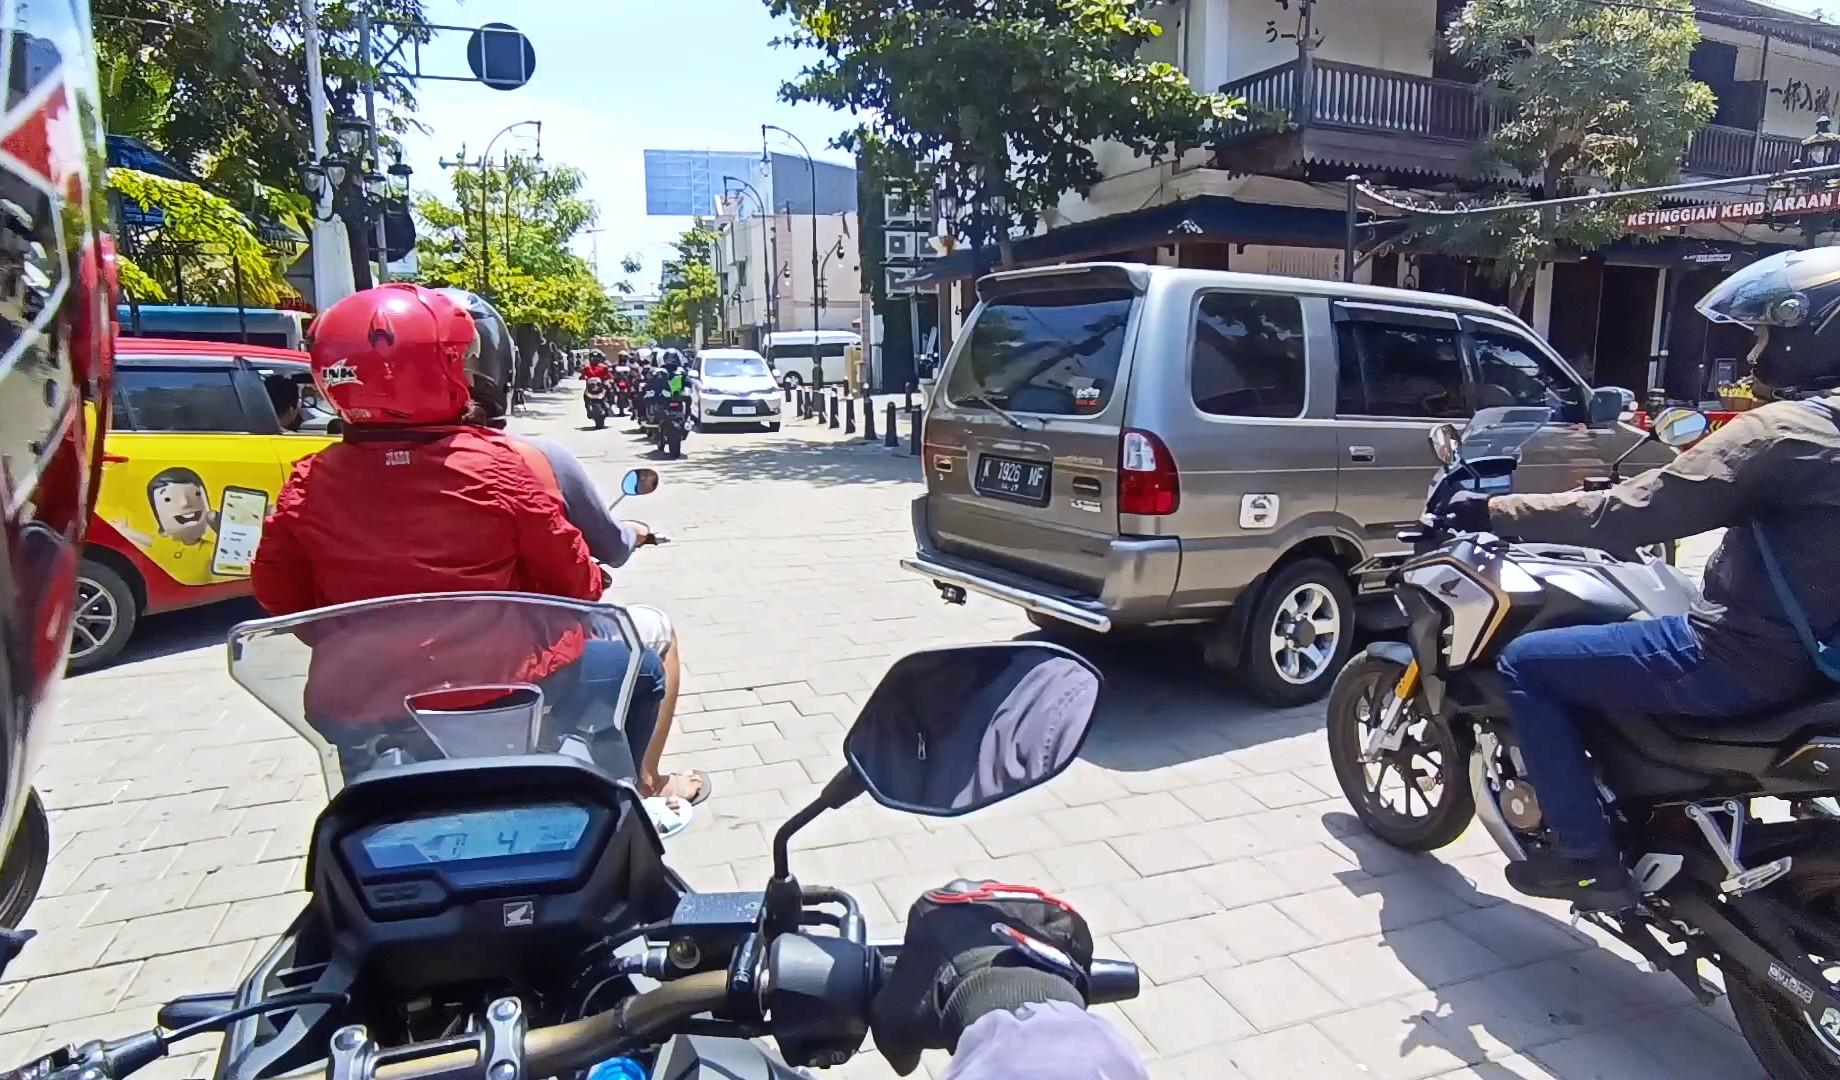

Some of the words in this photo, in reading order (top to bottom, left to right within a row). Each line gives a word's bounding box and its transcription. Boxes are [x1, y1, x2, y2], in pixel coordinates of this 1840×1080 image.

[1627, 206, 1717, 227] KETINGGIAN
[1721, 192, 1832, 218] KENDARAAN
[322, 367, 354, 379] INK
[983, 459, 992, 477] K
[998, 462, 1022, 482] 1926
